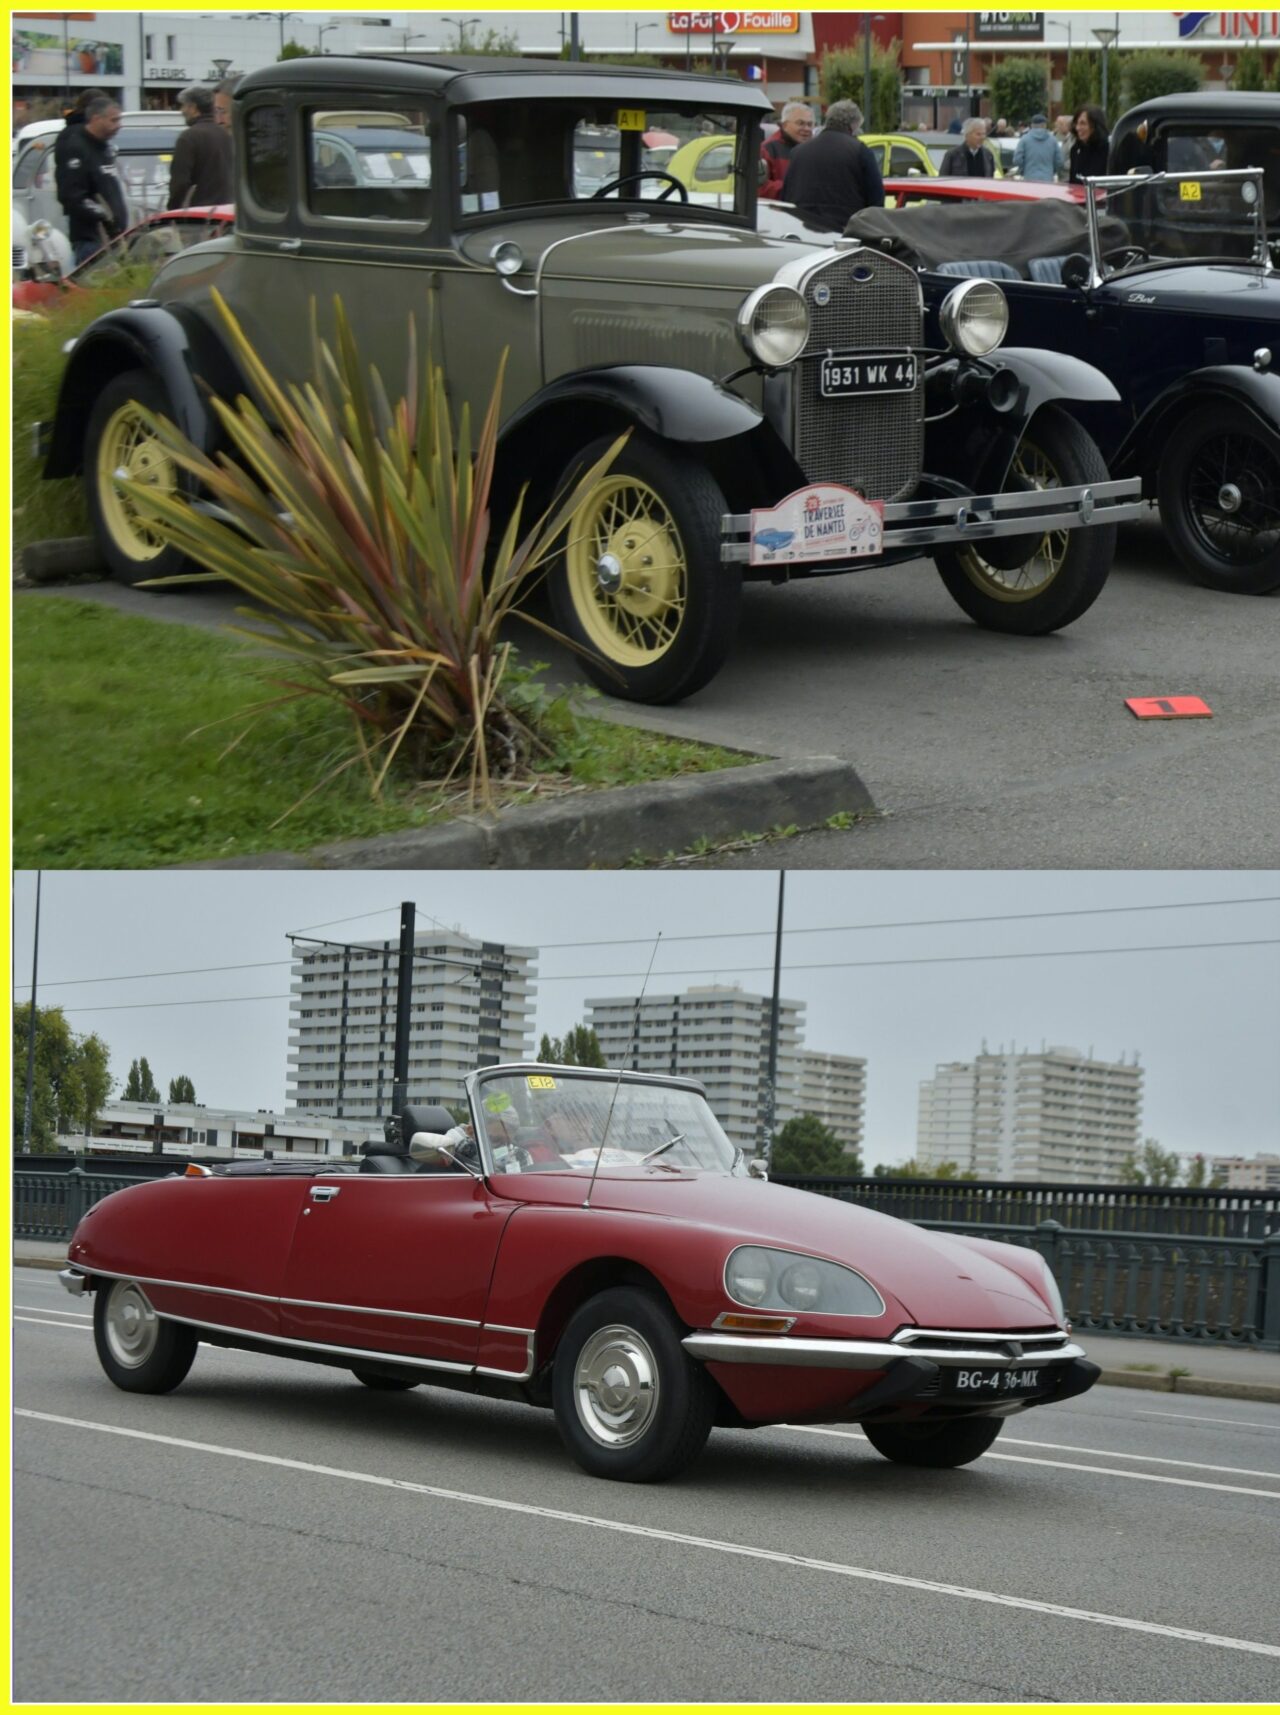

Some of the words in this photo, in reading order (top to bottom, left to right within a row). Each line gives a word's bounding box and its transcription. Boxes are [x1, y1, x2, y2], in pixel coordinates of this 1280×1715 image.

[824, 367, 860, 386] 1931
[867, 365, 888, 383] WK
[895, 363, 914, 382] 44
[804, 525, 815, 539] DE
[816, 519, 846, 537] NANTES
